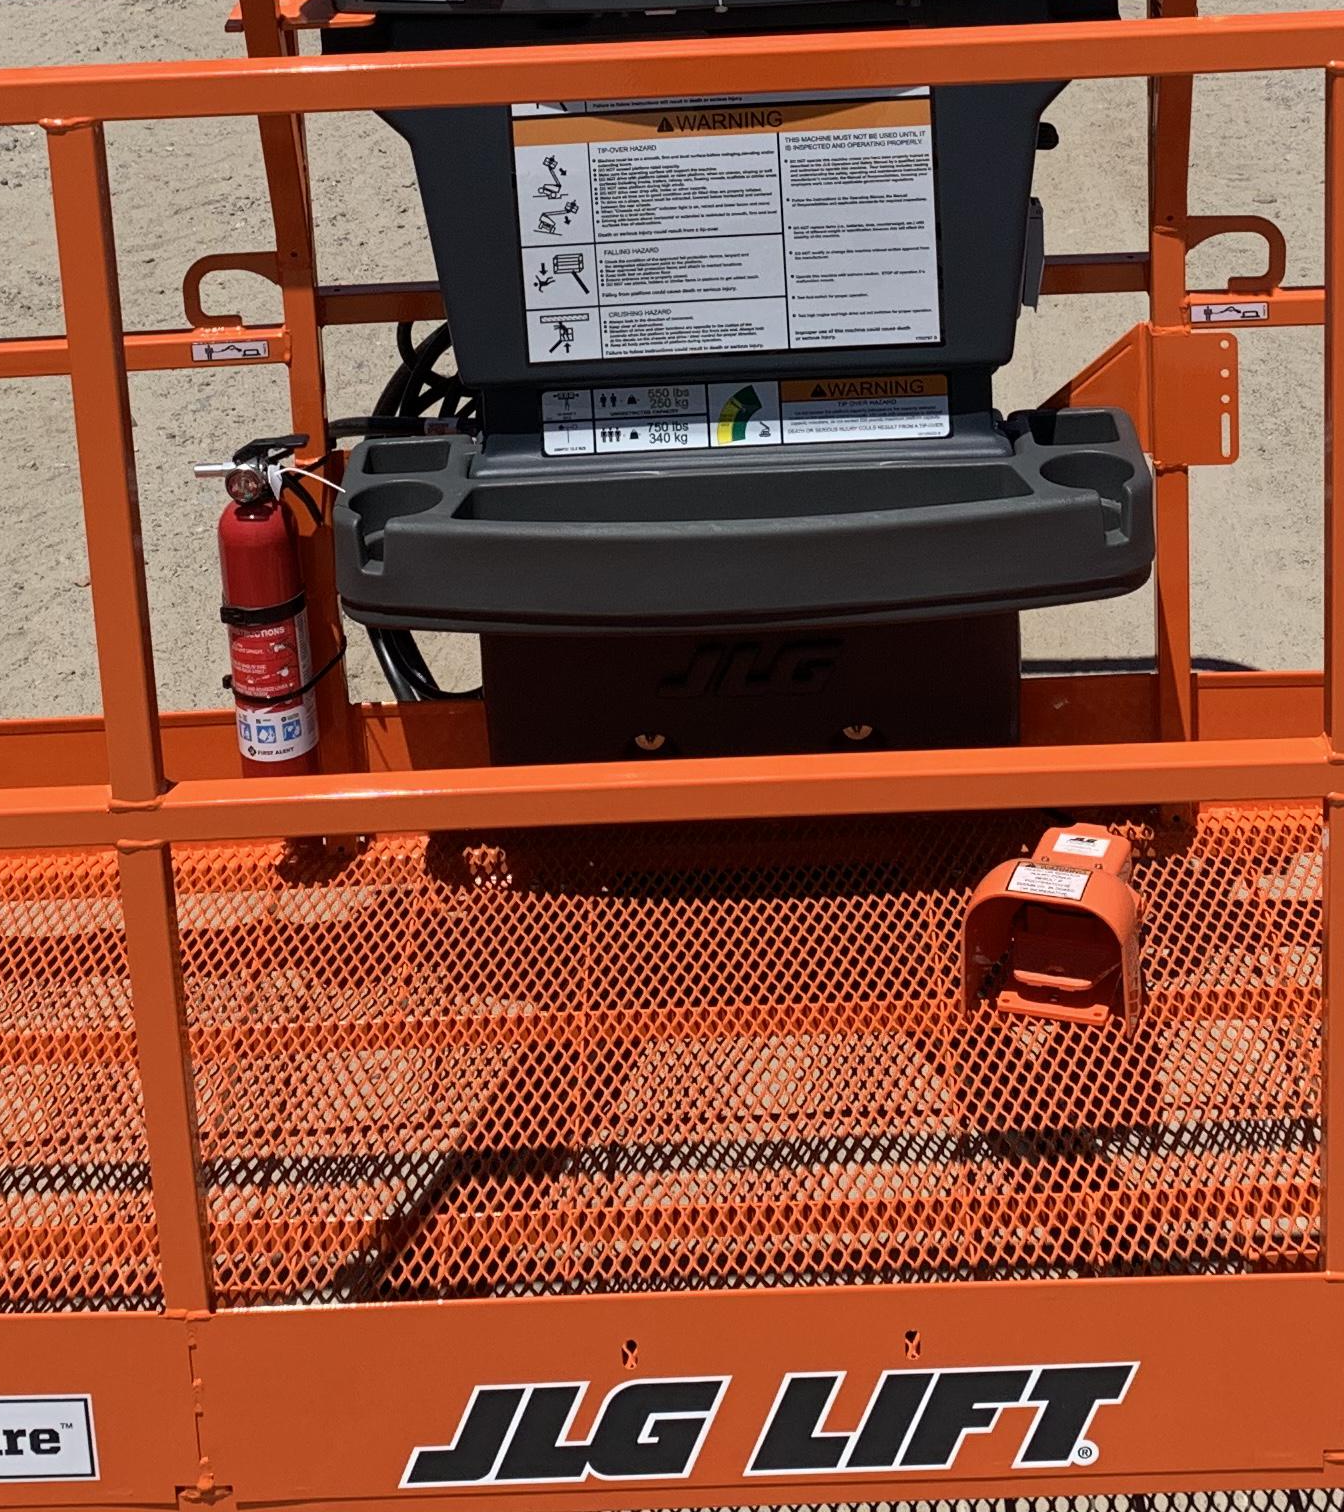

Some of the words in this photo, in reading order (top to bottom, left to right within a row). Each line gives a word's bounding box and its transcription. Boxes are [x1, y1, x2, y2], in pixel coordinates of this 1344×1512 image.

[675, 110, 784, 132] WARNING
[597, 144, 628, 154] TIP-OVER
[628, 144, 657, 153] HAZARD
[603, 248, 631, 256] FALLING
[631, 246, 660, 255] HAZARD
[608, 310, 644, 318] CRUSHING
[644, 308, 672, 316] HAZARD
[647, 387, 671, 398] 550
[672, 385, 690, 398] lbs
[827, 378, 925, 398] WARNING
[650, 398, 672, 408] 250
[674, 396, 689, 410] kg
[647, 422, 669, 432] 750
[671, 420, 689, 432] lbs
[648, 434, 671, 444] 340
[674, 432, 688, 445] kg
[660, 637, 844, 697] JLG
[275, 746, 295, 755] ALERT
[400, 1375, 732, 1488] JLG
